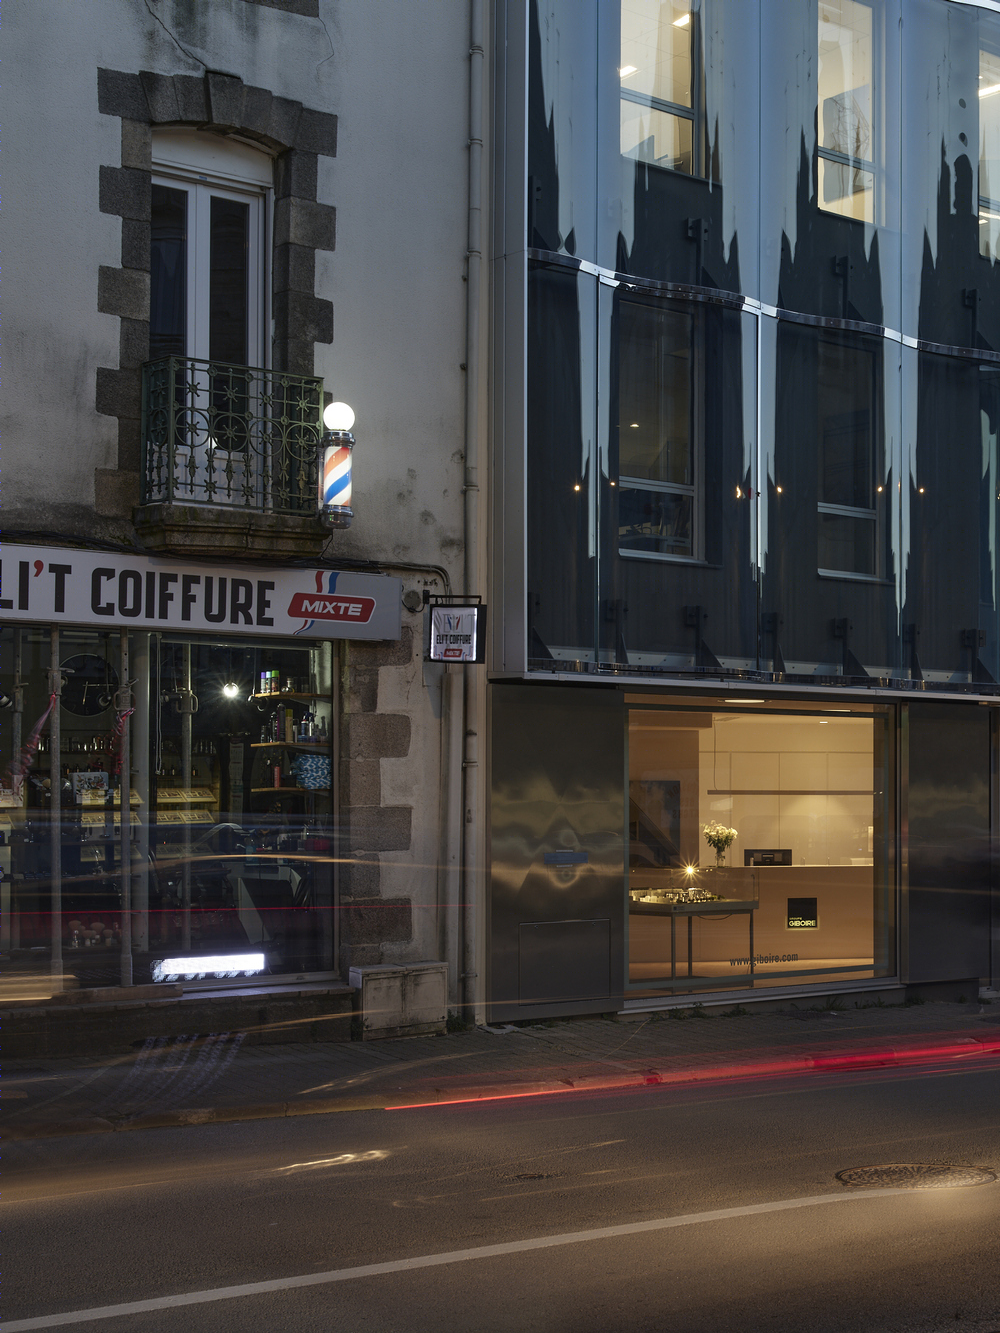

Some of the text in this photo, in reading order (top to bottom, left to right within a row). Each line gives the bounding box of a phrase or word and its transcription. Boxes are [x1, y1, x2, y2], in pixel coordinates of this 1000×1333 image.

[91, 566, 275, 627] COIFFURE
[300, 598, 363, 616] MIXTE
[450, 634, 471, 644] COIFFURE
[729, 953, 799, 967] www.giboire.com
